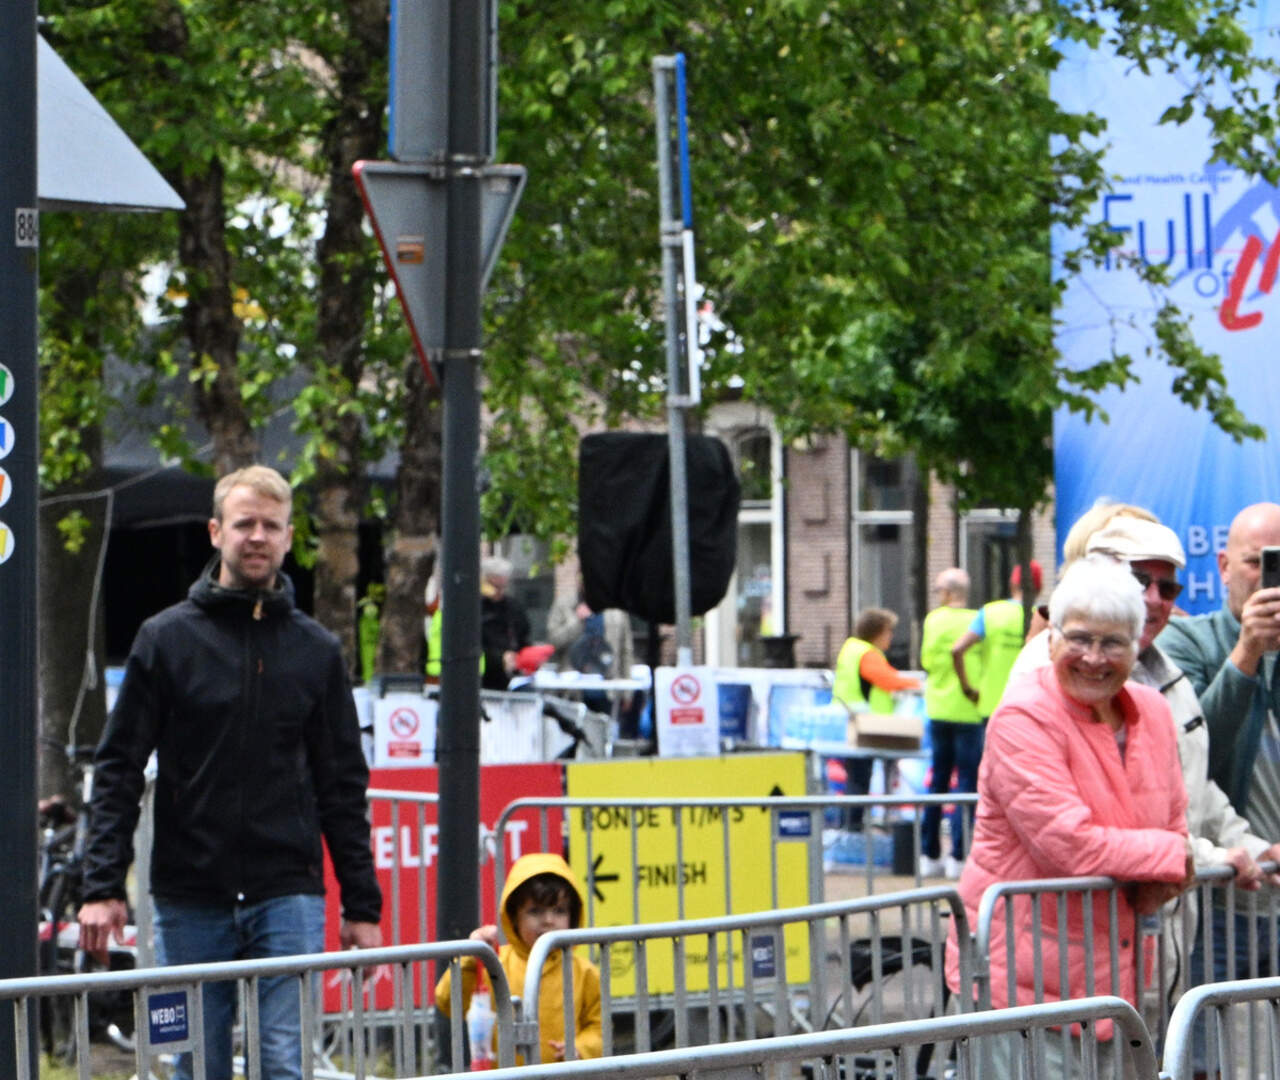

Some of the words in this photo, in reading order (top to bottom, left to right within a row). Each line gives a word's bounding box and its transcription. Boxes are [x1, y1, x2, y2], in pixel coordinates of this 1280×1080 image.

[1102, 192, 1212, 271] Full
[637, 863, 708, 887] FINISH
[151, 1006, 176, 1025] WEBO
